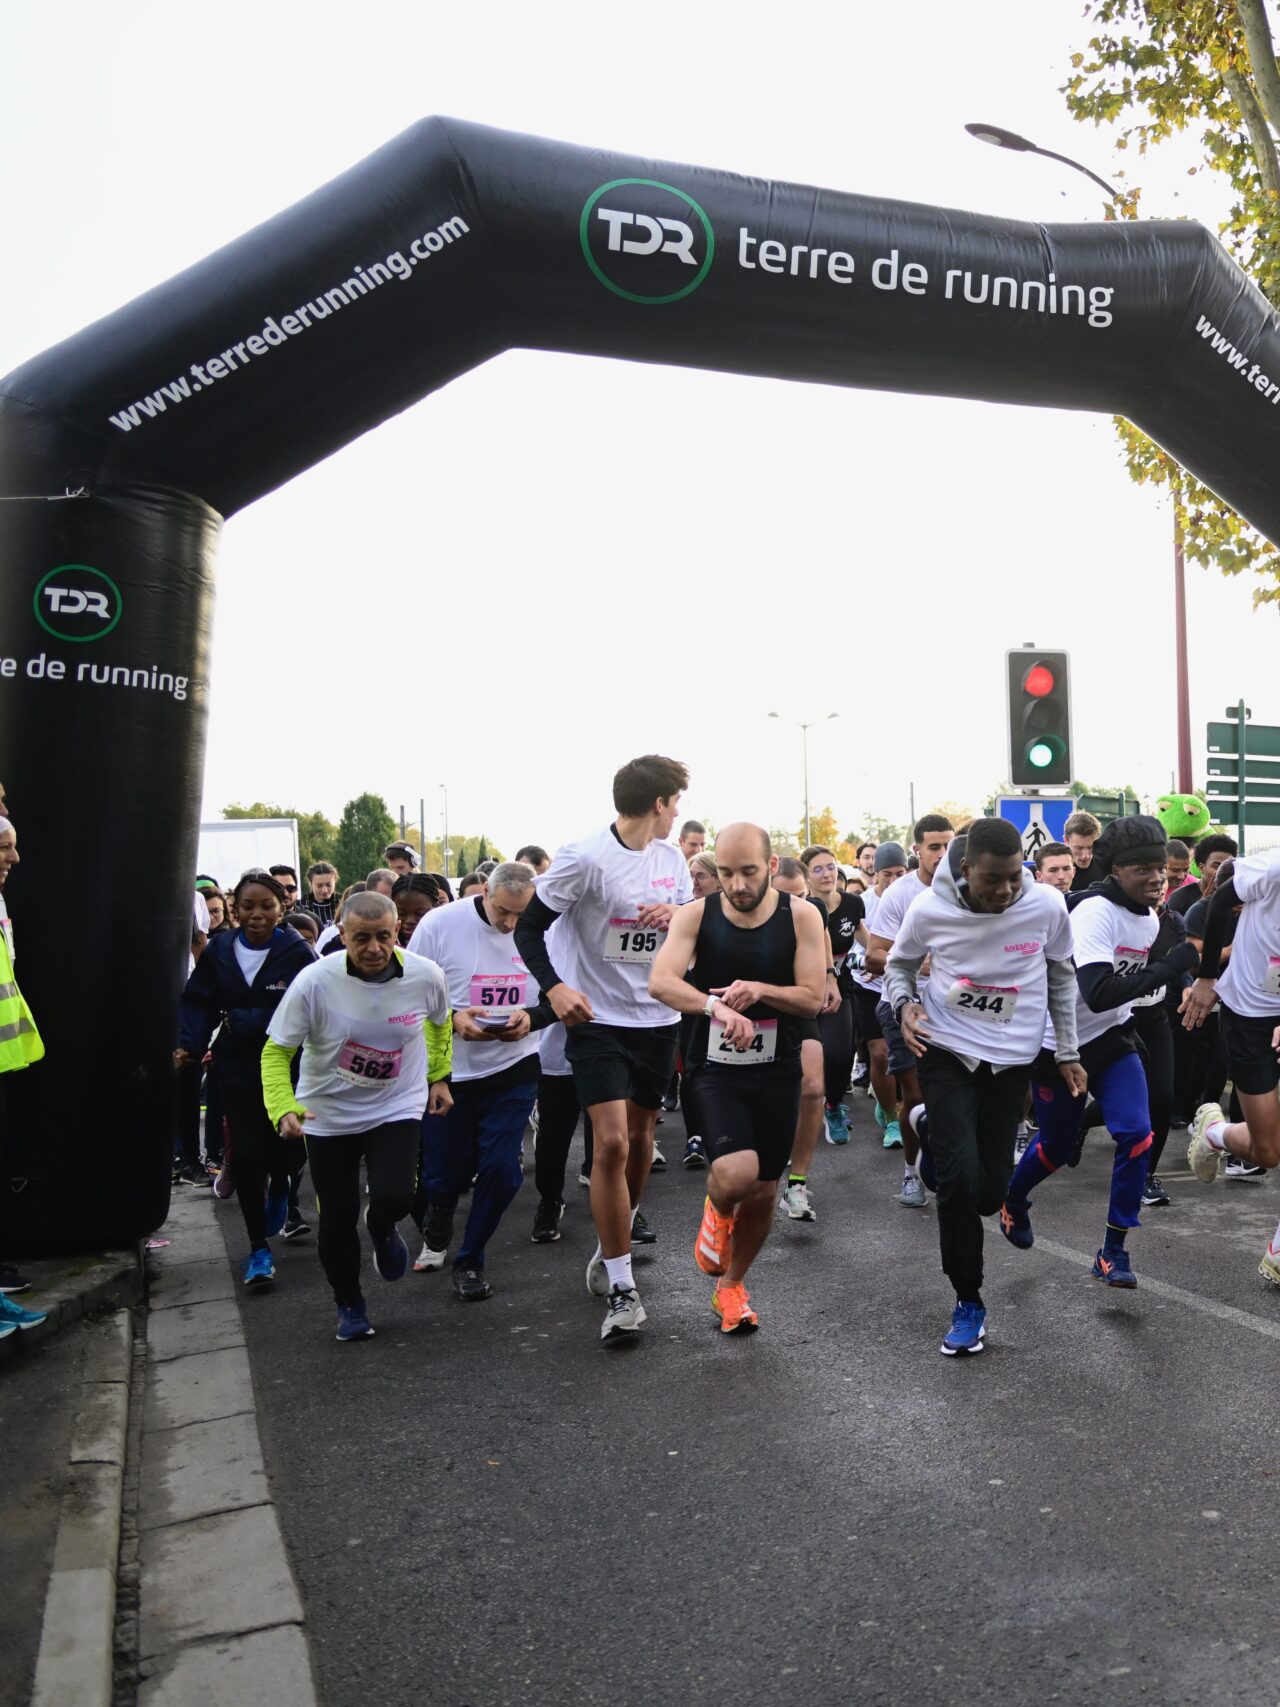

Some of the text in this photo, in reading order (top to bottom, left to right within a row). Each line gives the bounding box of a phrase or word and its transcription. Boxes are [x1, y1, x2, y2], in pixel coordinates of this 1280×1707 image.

[598, 208, 698, 265] TDR
[738, 227, 1114, 328] terre de running
[109, 216, 470, 432] www.terrederunning.com
[44, 587, 111, 618] TDR
[26, 653, 66, 679] de
[77, 663, 188, 700] running
[620, 932, 657, 953] 195
[480, 987, 520, 1006] 570
[957, 992, 1004, 1014] 244
[350, 1054, 394, 1079] 562
